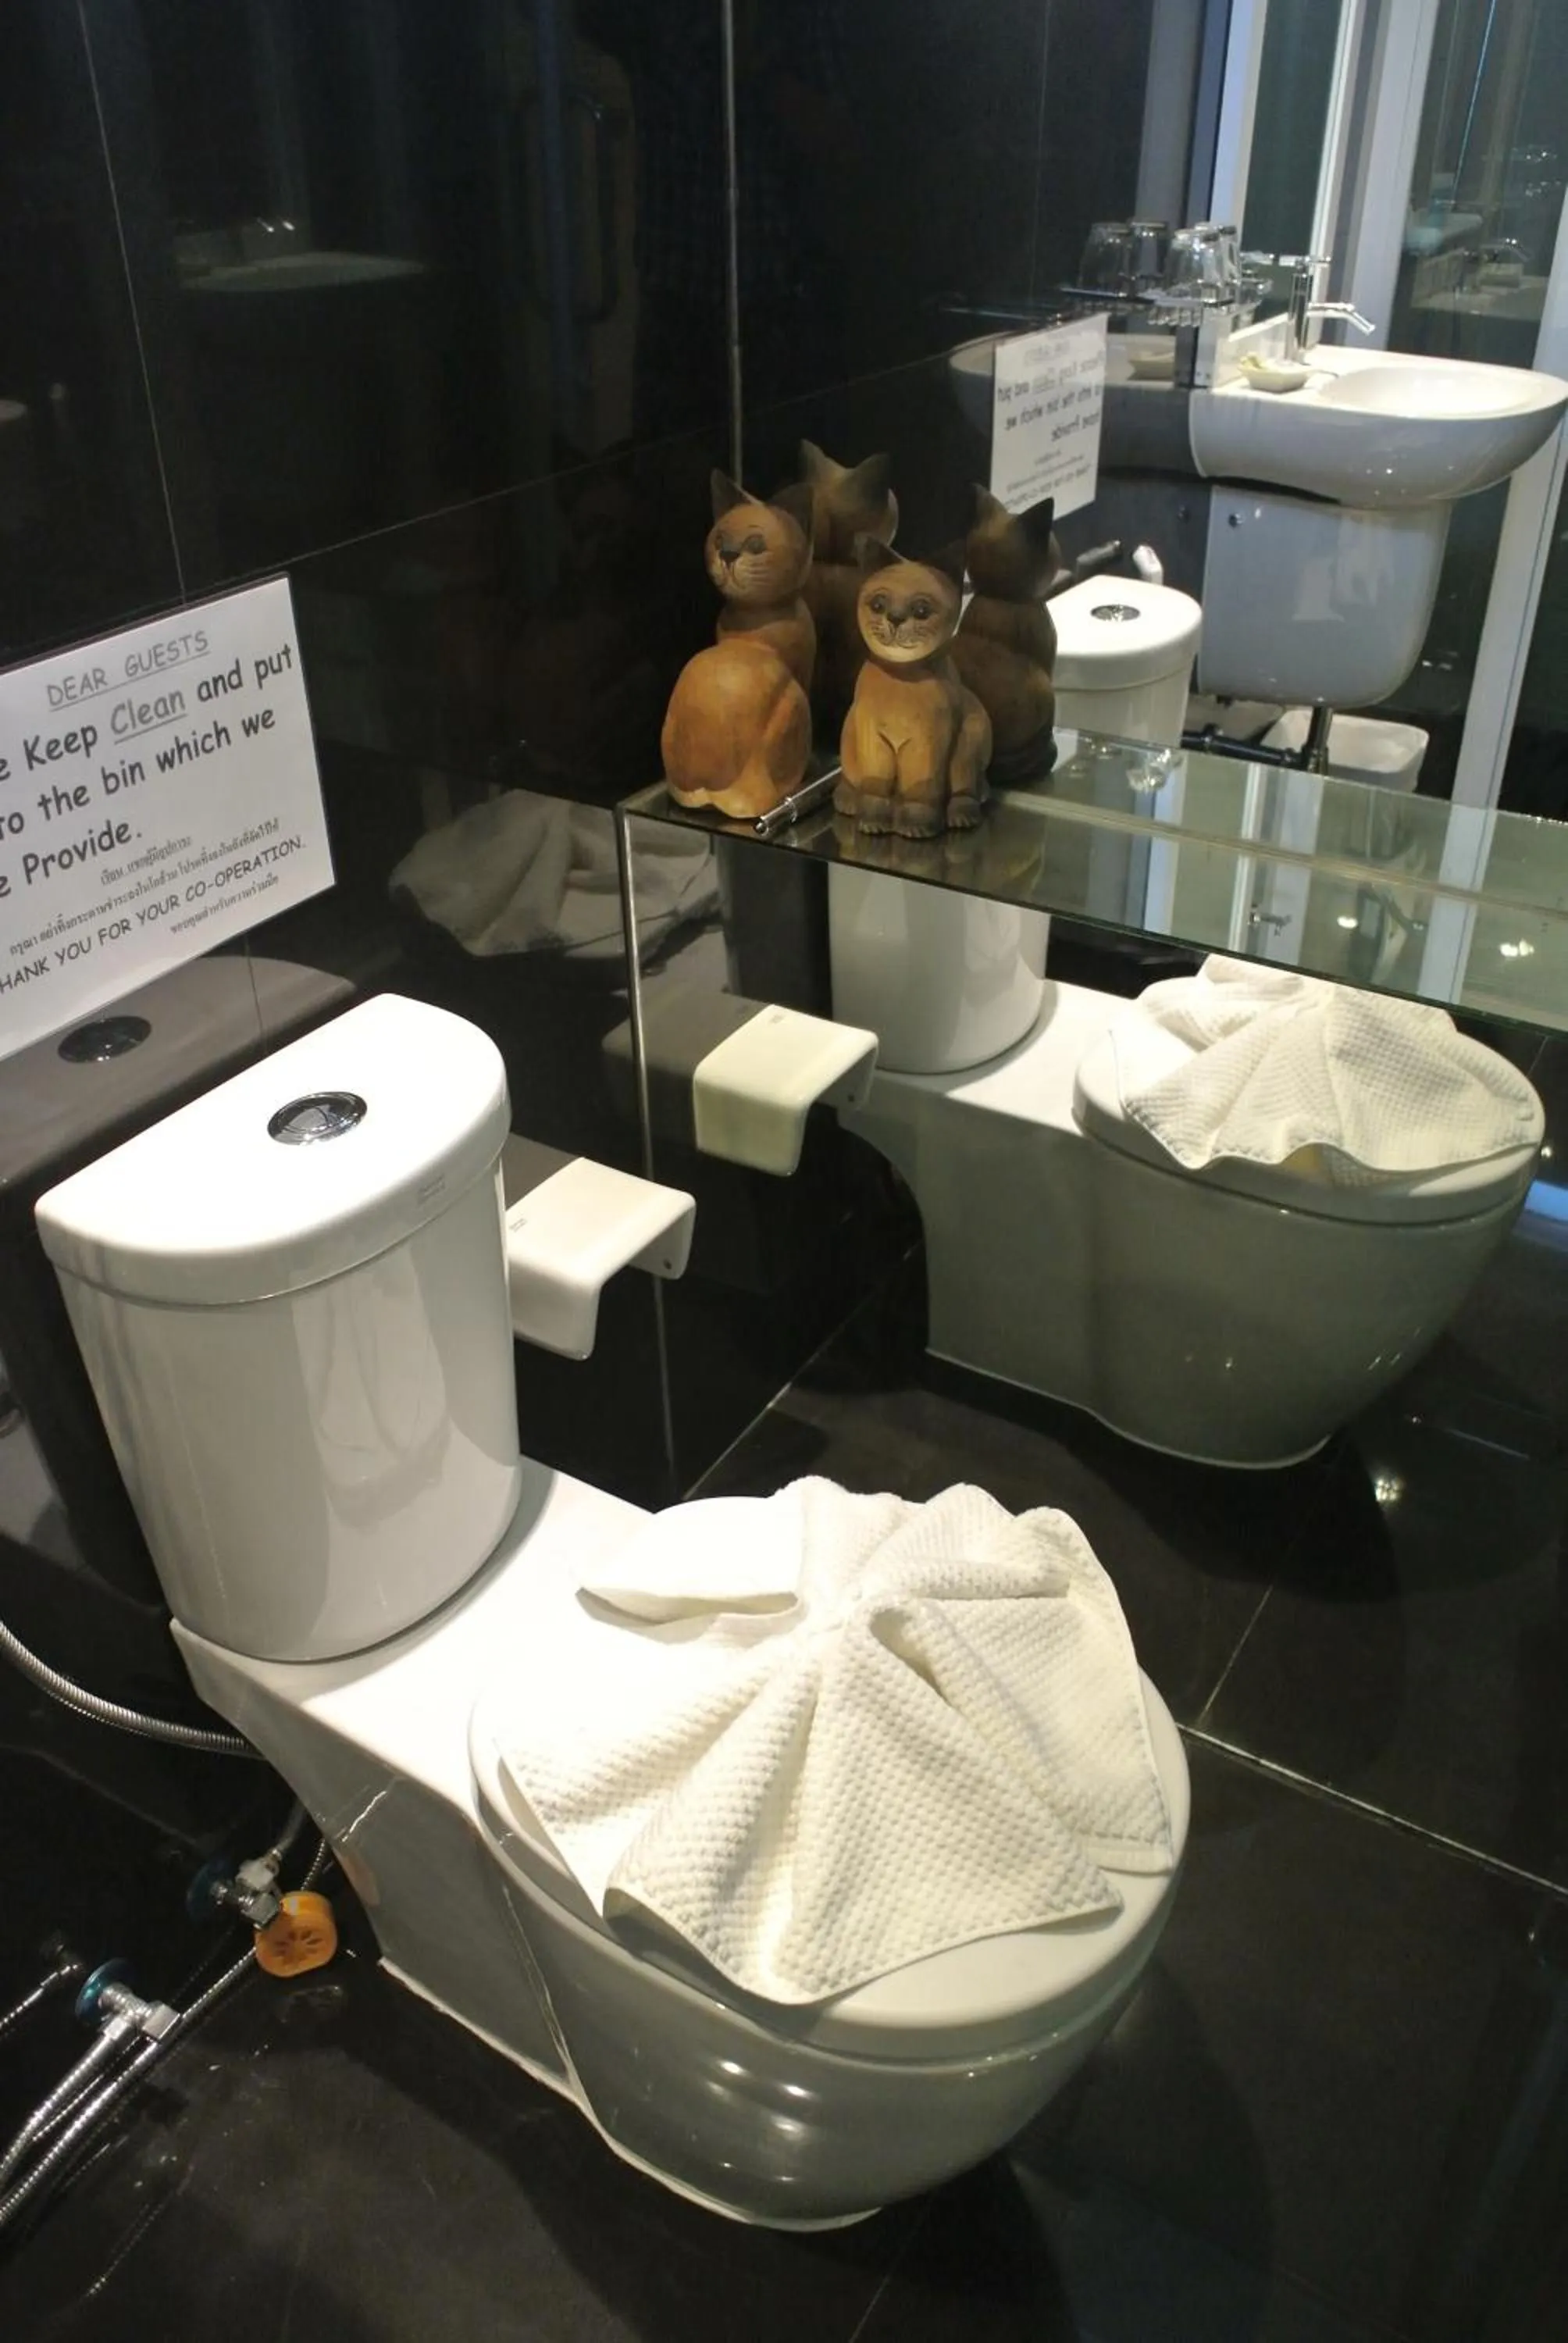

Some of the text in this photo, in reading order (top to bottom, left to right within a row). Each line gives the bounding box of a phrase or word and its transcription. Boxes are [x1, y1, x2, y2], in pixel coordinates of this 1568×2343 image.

[46, 630, 208, 706] DEAR GUESTS
[23, 725, 98, 771] Keep
[110, 690, 186, 735] Clean
[196, 658, 244, 702] and
[254, 644, 292, 690] put
[37, 784, 91, 821] the
[101, 760, 146, 796] bin
[156, 720, 231, 773] which
[241, 708, 276, 737] we
[22, 819, 142, 886] Provide.
[55, 936, 92, 966] YOU
[98, 918, 132, 947] FOR
[136, 894, 180, 925] YOUR
